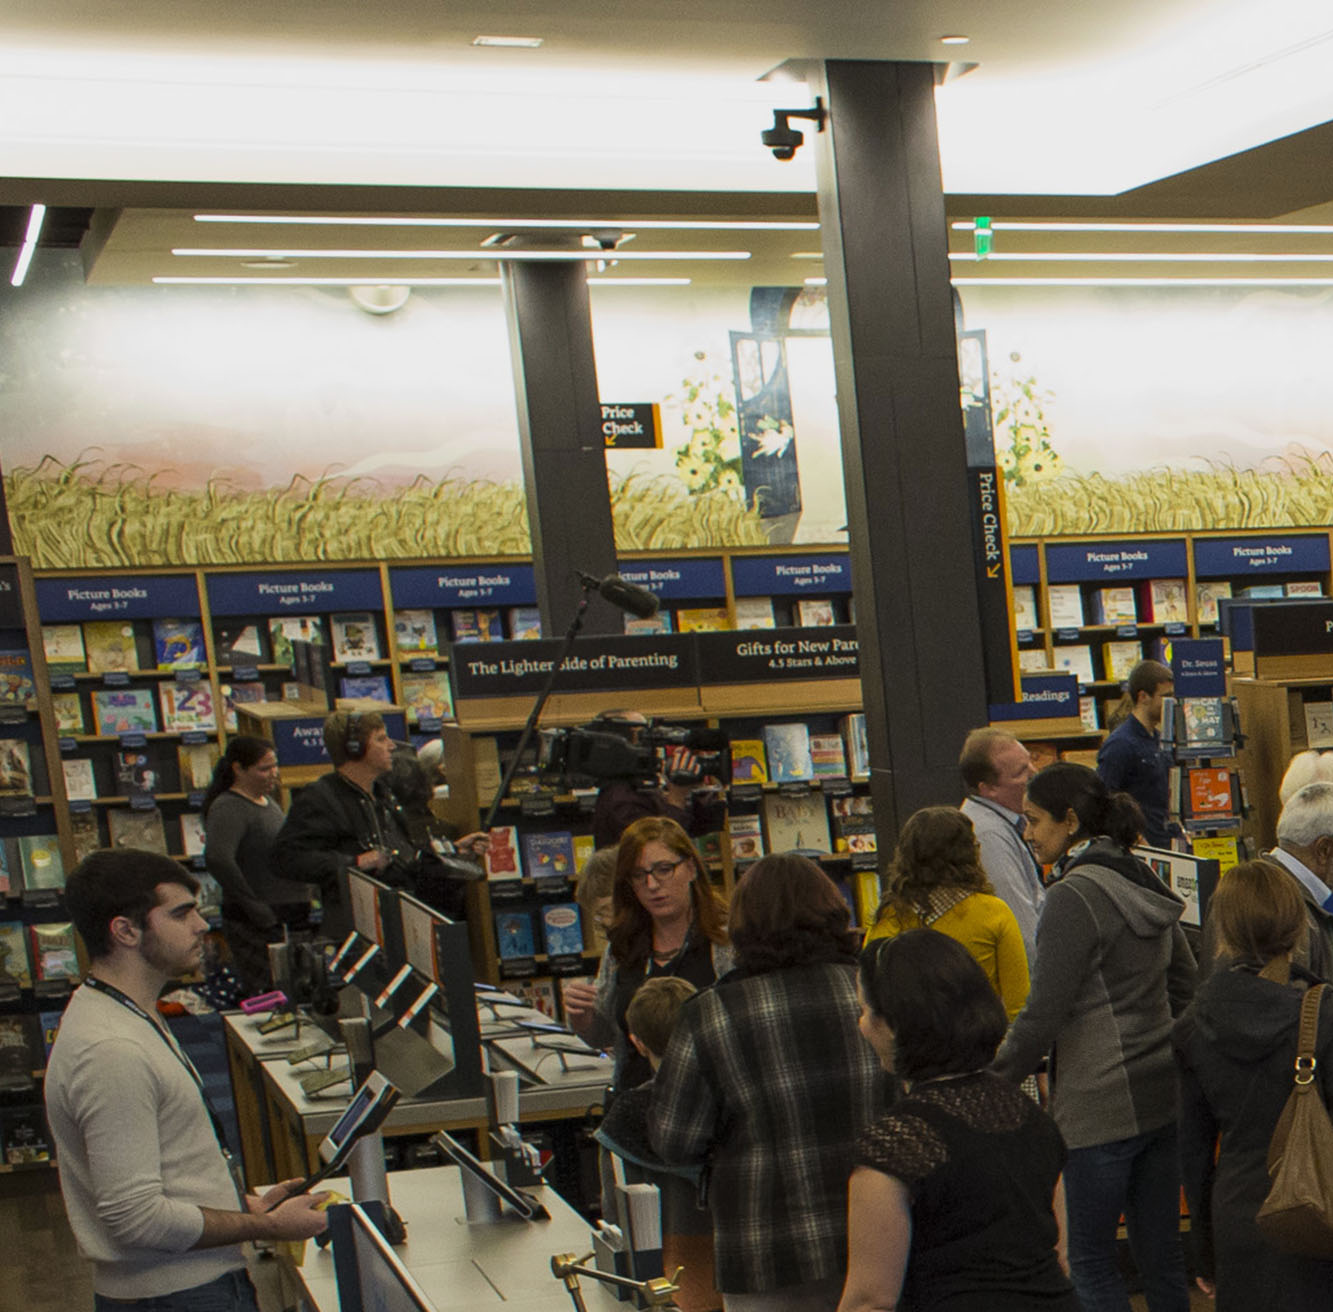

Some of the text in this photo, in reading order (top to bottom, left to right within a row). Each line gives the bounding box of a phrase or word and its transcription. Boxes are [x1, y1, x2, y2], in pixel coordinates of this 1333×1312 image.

[602, 405, 634, 419] Price
[603, 421, 645, 435] Check
[980, 473, 1000, 560] Price Check
[438, 574, 510, 588] Picture Books
[68, 587, 147, 601] Picture Books
[737, 640, 829, 657] Gifts for New
[469, 661, 498, 676] The
[500, 657, 554, 675] Lighter
[591, 655, 606, 670] of
[606, 653, 678, 669] Parenting
